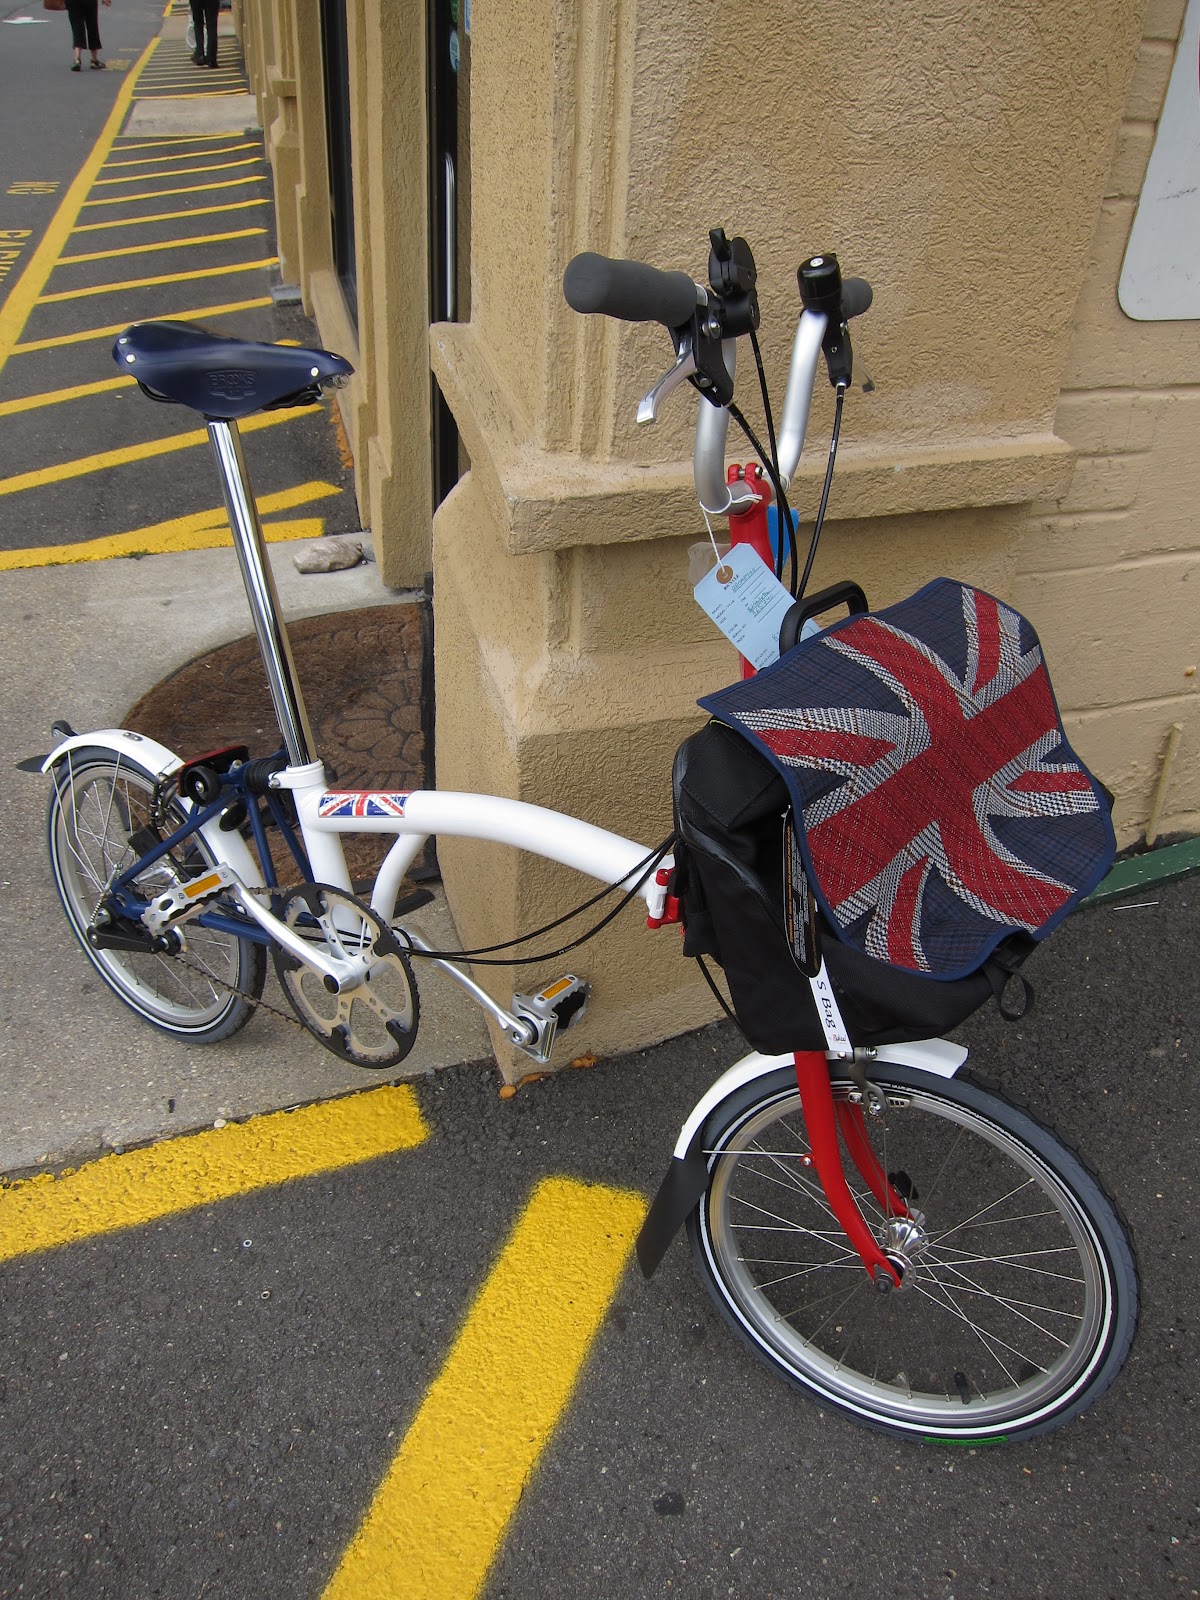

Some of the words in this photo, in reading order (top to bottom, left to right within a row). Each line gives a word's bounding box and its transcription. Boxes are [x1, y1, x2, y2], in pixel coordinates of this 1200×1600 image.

[6, 181, 61, 195] NO
[209, 373, 255, 386] BROOKS
[816, 980, 827, 991] S
[821, 997, 837, 1029] Bag
